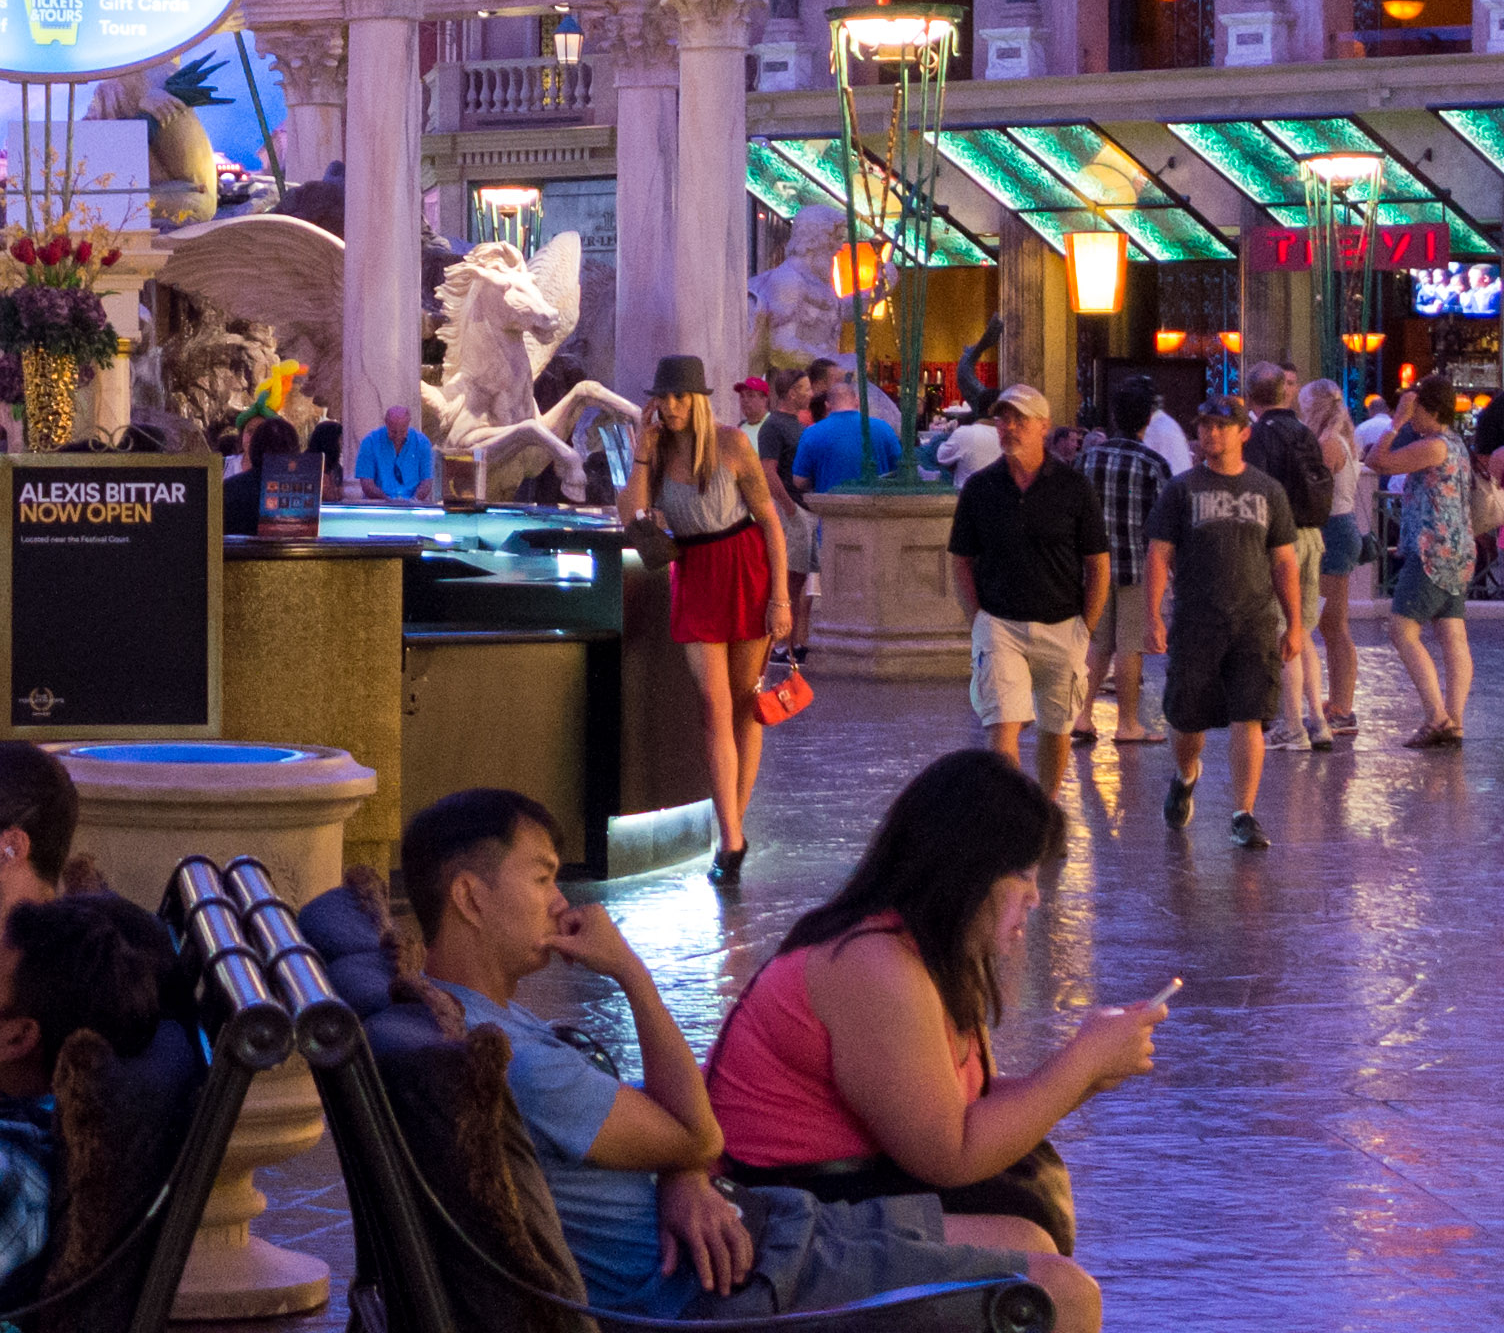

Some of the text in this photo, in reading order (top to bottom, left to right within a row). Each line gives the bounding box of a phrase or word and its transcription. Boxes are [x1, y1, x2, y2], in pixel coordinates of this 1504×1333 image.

[30, 9, 83, 23] &TOURS
[99, 19, 147, 36] Tours
[19, 482, 186, 503] ALEXIS BITTAR
[20, 503, 152, 523] NOW OPEN
[20, 535, 50, 544] Located
[67, 535, 80, 544] the
